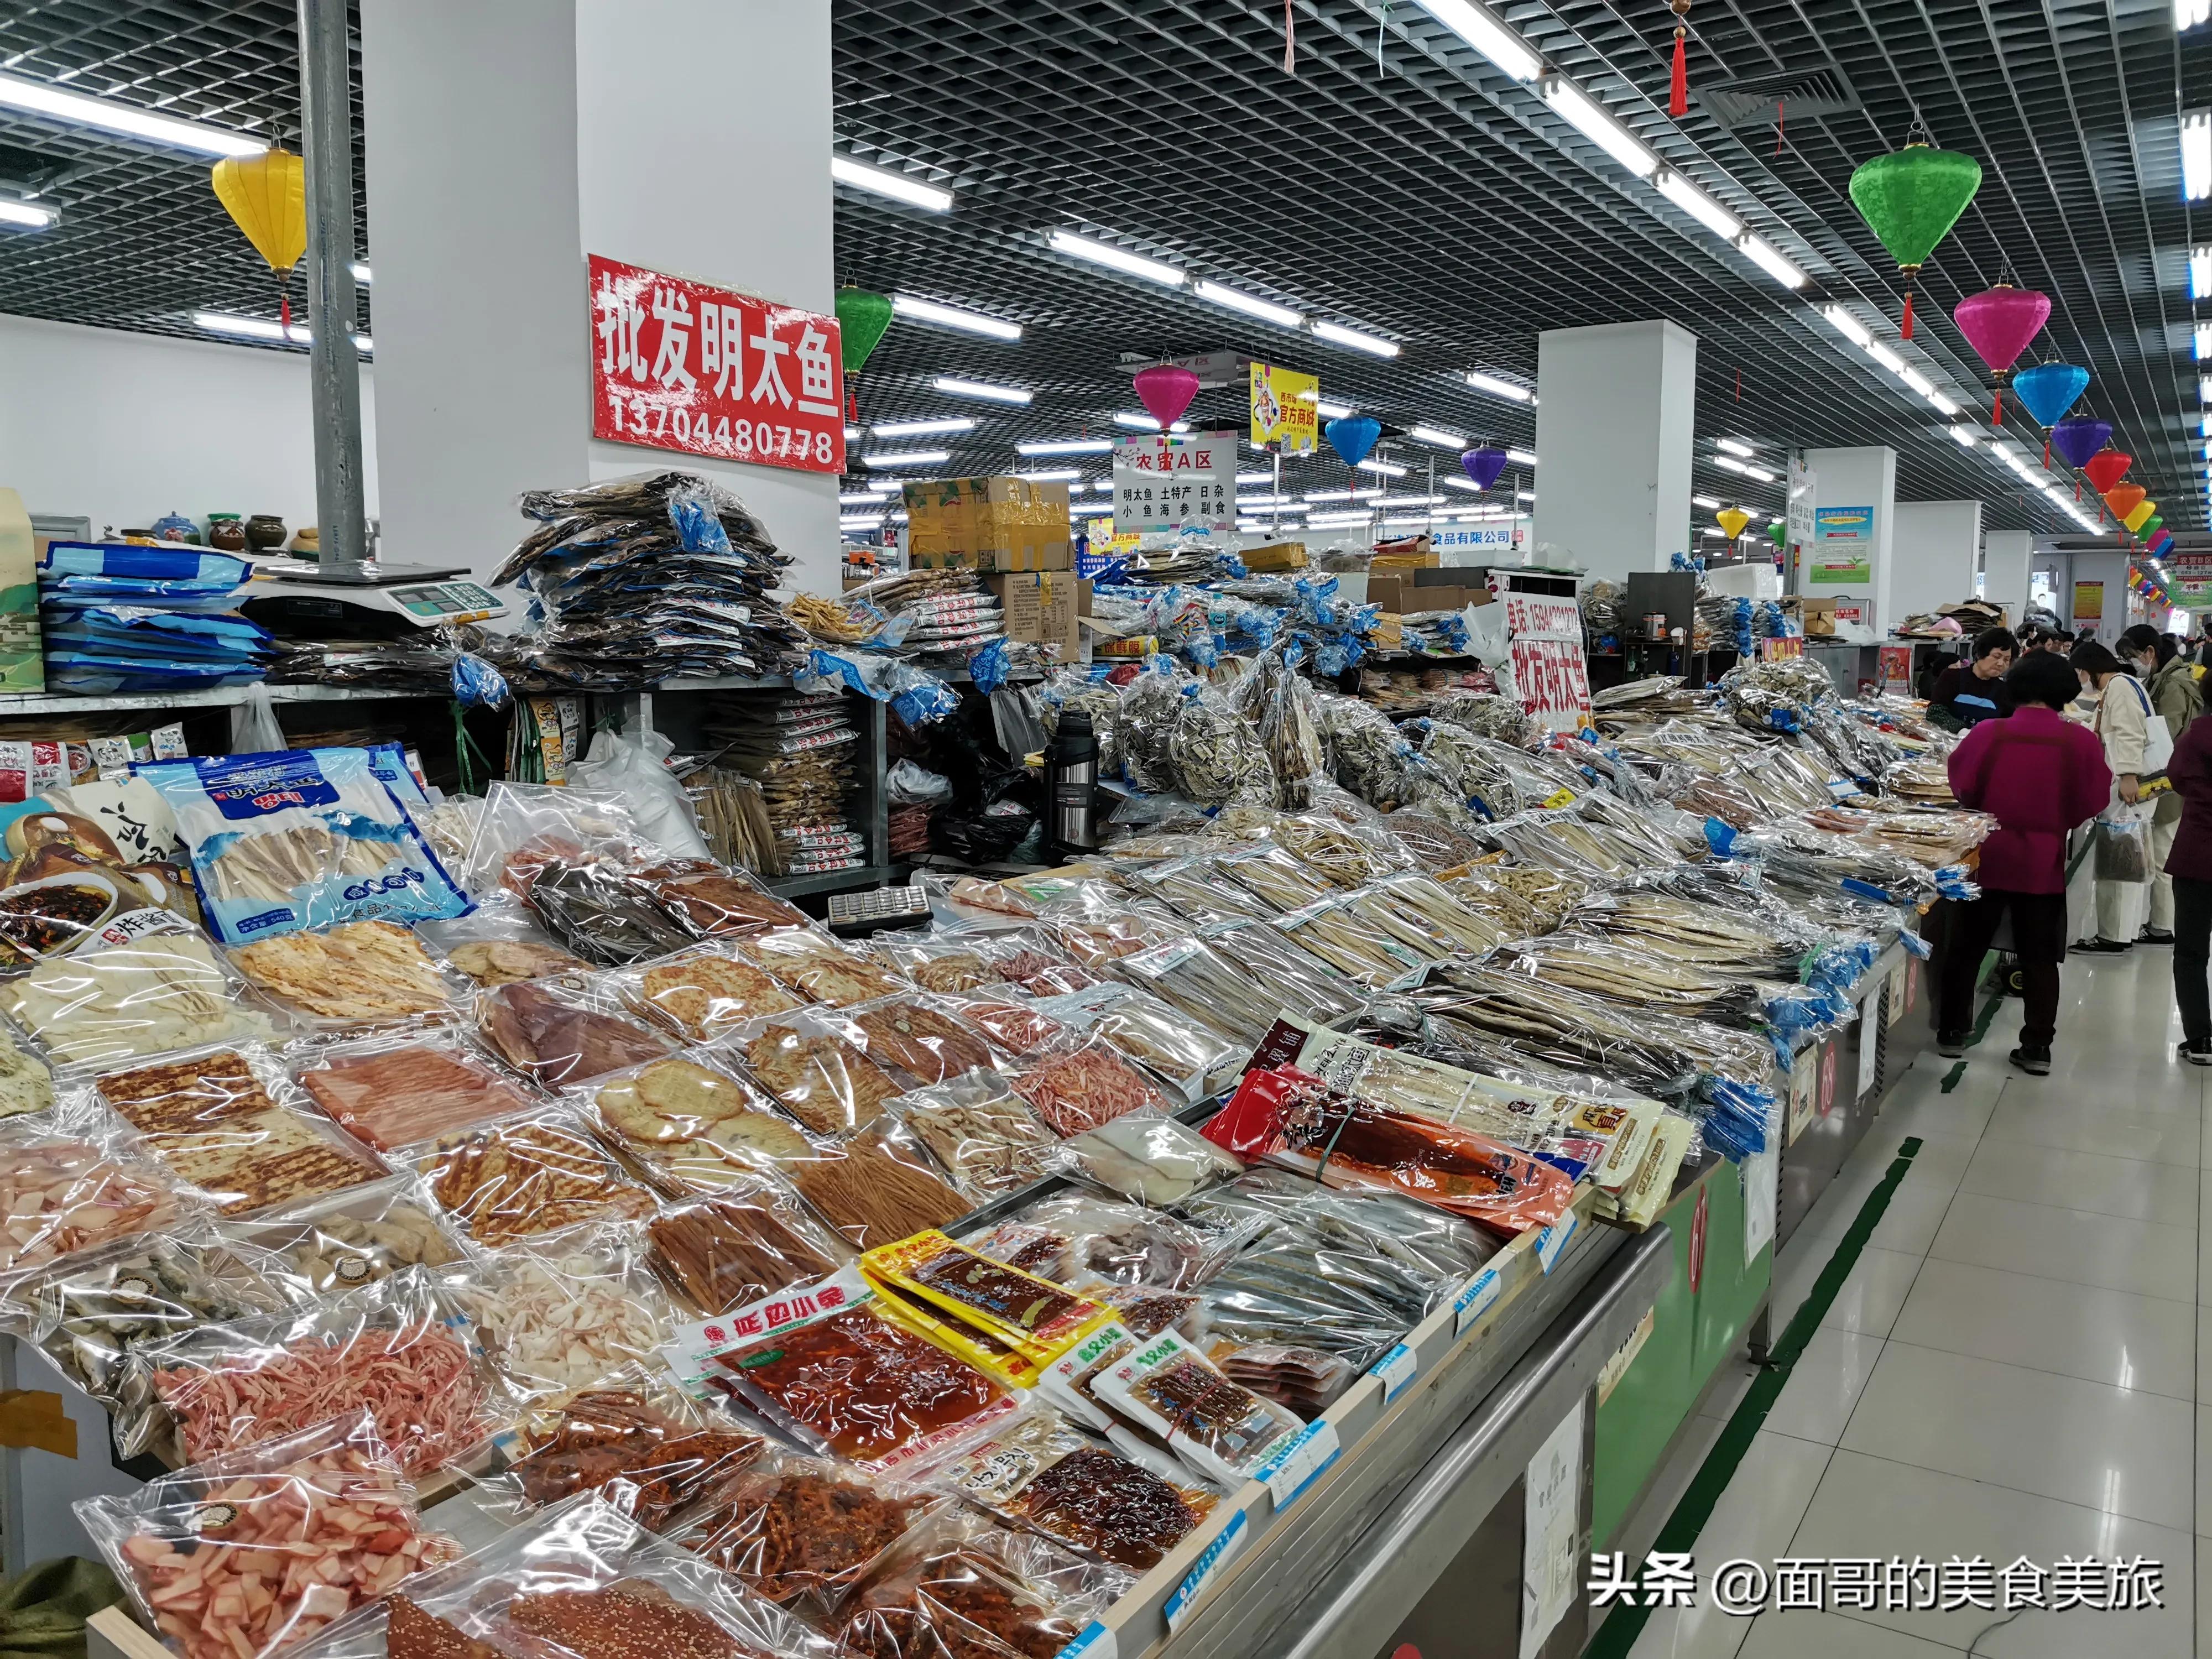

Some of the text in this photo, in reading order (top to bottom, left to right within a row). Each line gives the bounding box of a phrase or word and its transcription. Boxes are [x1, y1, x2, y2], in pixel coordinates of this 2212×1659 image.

[598, 270, 839, 418] 批发明太鱼
[1280, 404, 1315, 427] 官方商城
[609, 396, 834, 465] 13704480778
[1136, 450, 1212, 471] 农贸A区
[1123, 484, 1224, 502] 明太鱼 土特产 日杂
[1123, 501, 1225, 518] 小鱼 海参 副食
[1381, 529, 1511, 546] 食品有限公司
[1512, 640, 1592, 714] 批发明太鱼
